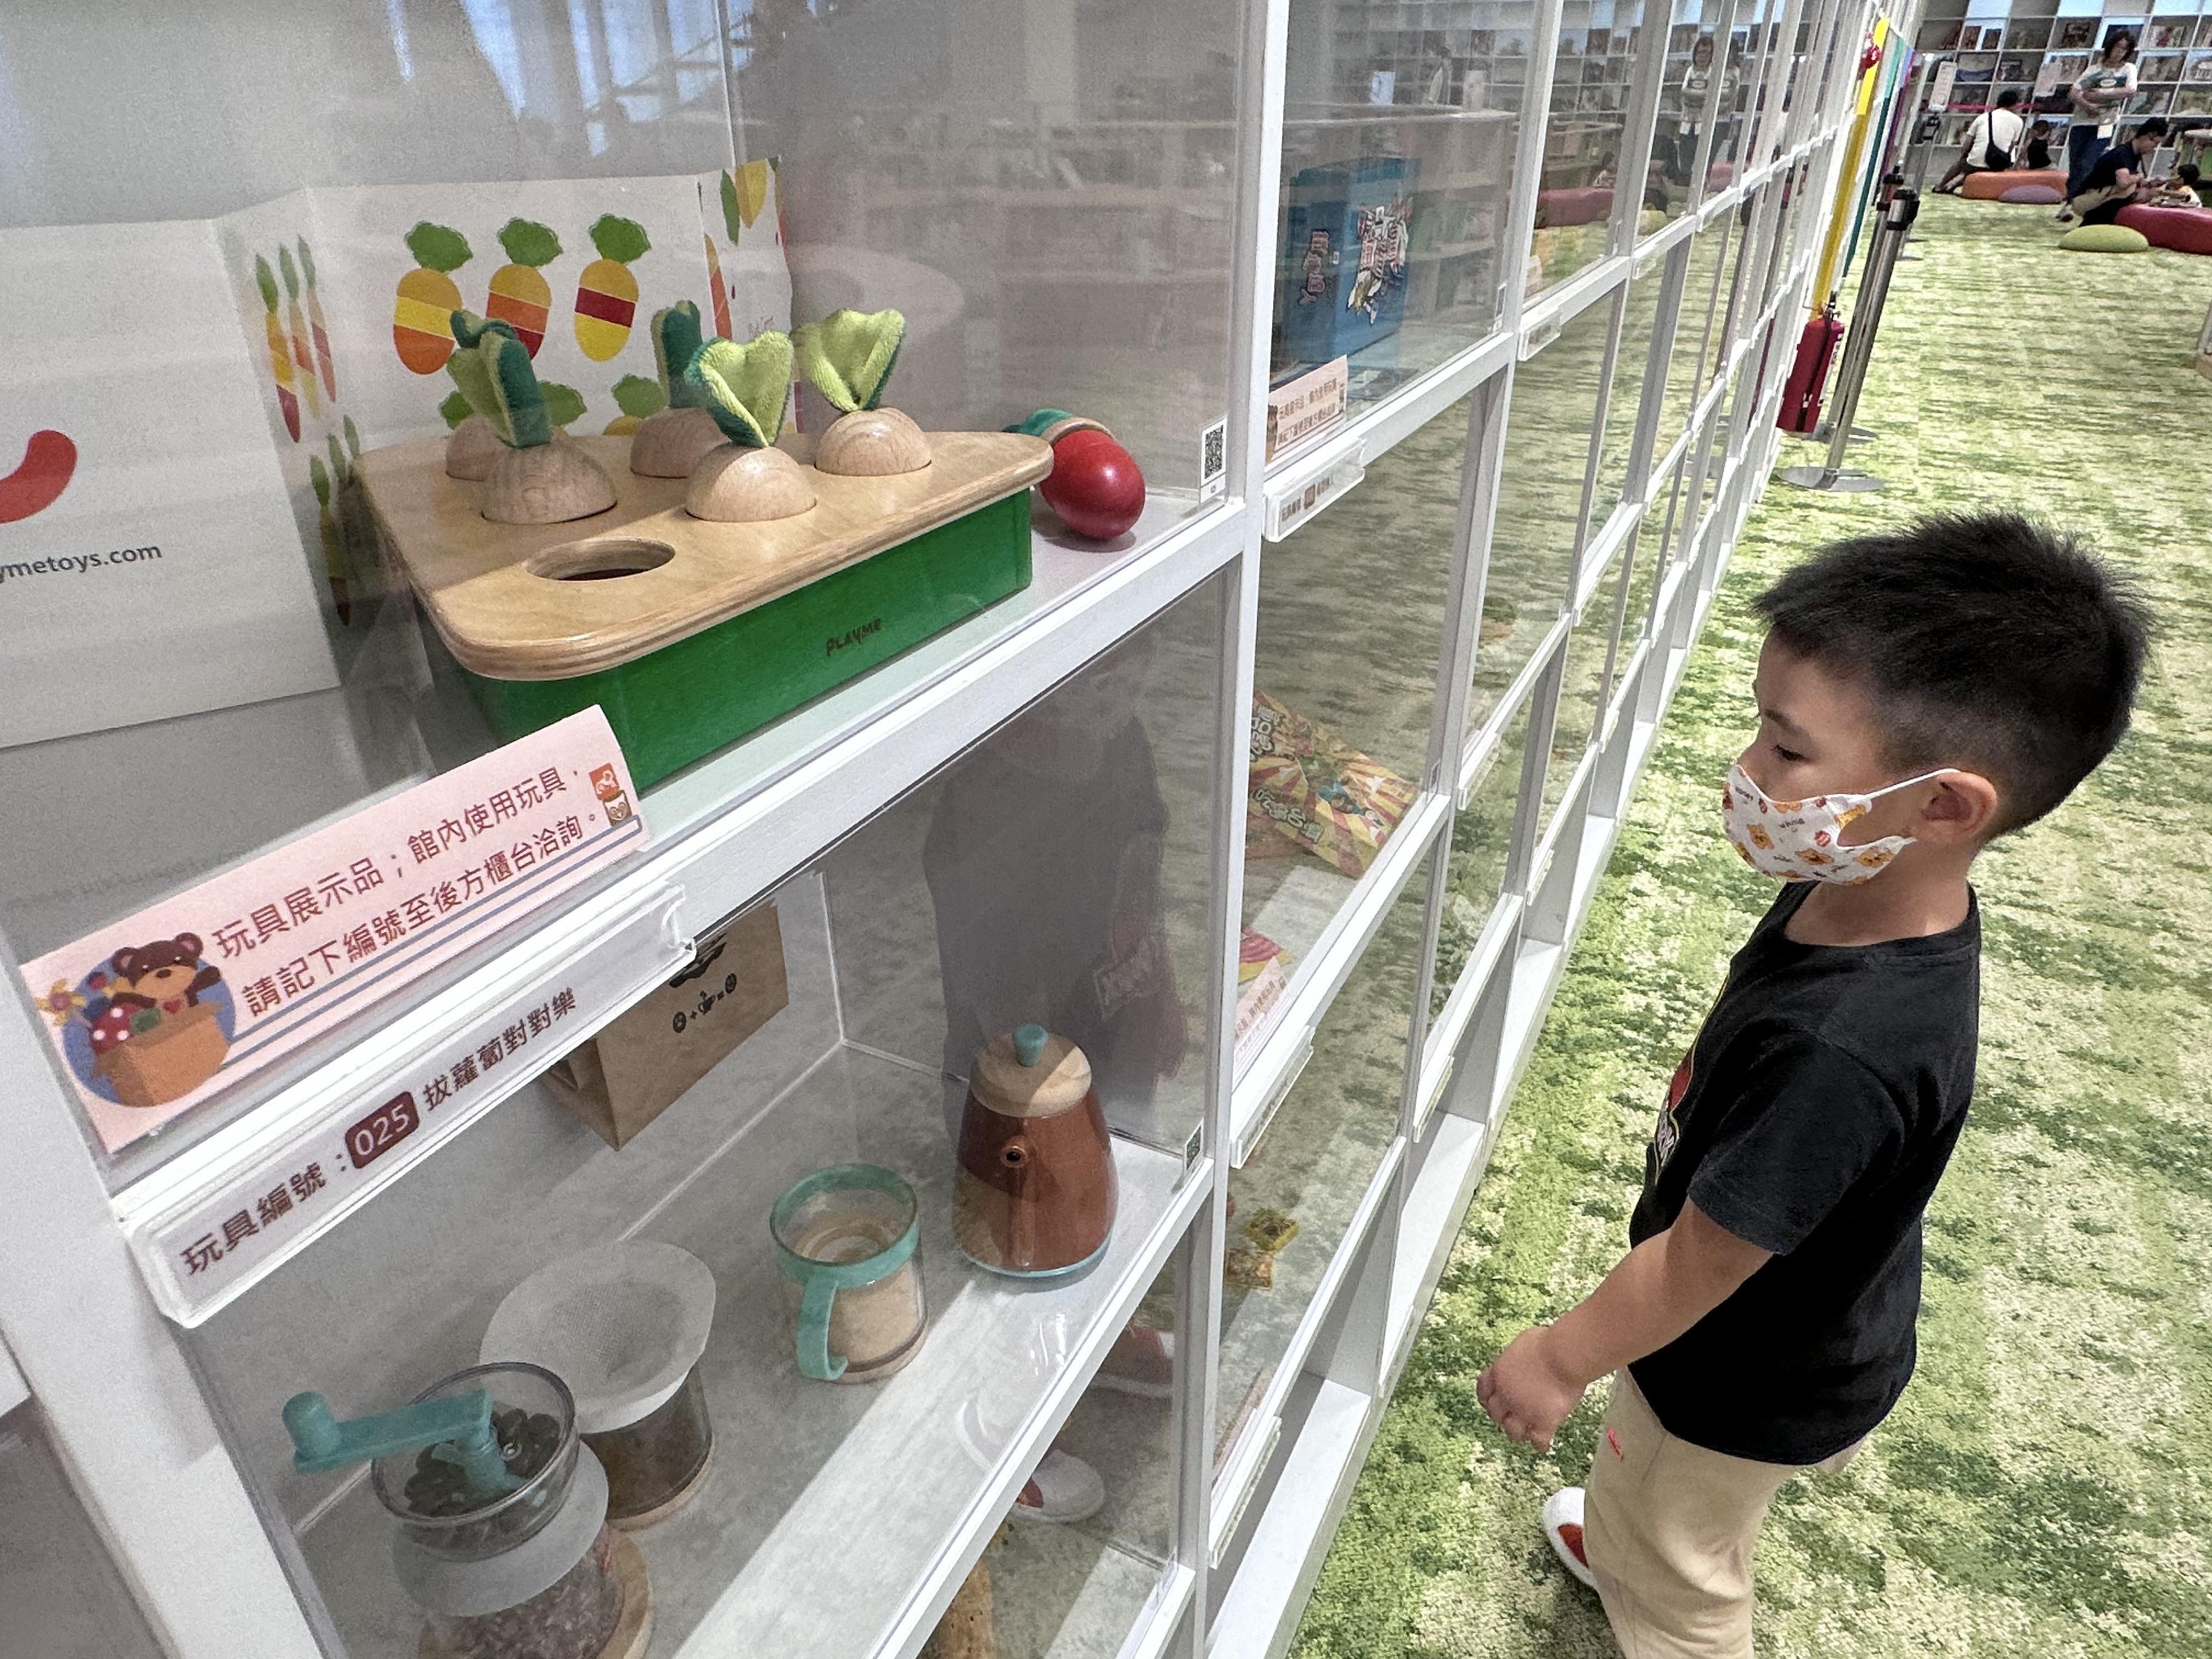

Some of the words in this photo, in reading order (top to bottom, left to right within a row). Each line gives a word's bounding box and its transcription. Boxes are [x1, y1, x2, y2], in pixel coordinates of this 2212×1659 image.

[353, 1103, 410, 1157] 025
[422, 987, 577, 1111] 拔蘿蔔對對樂
